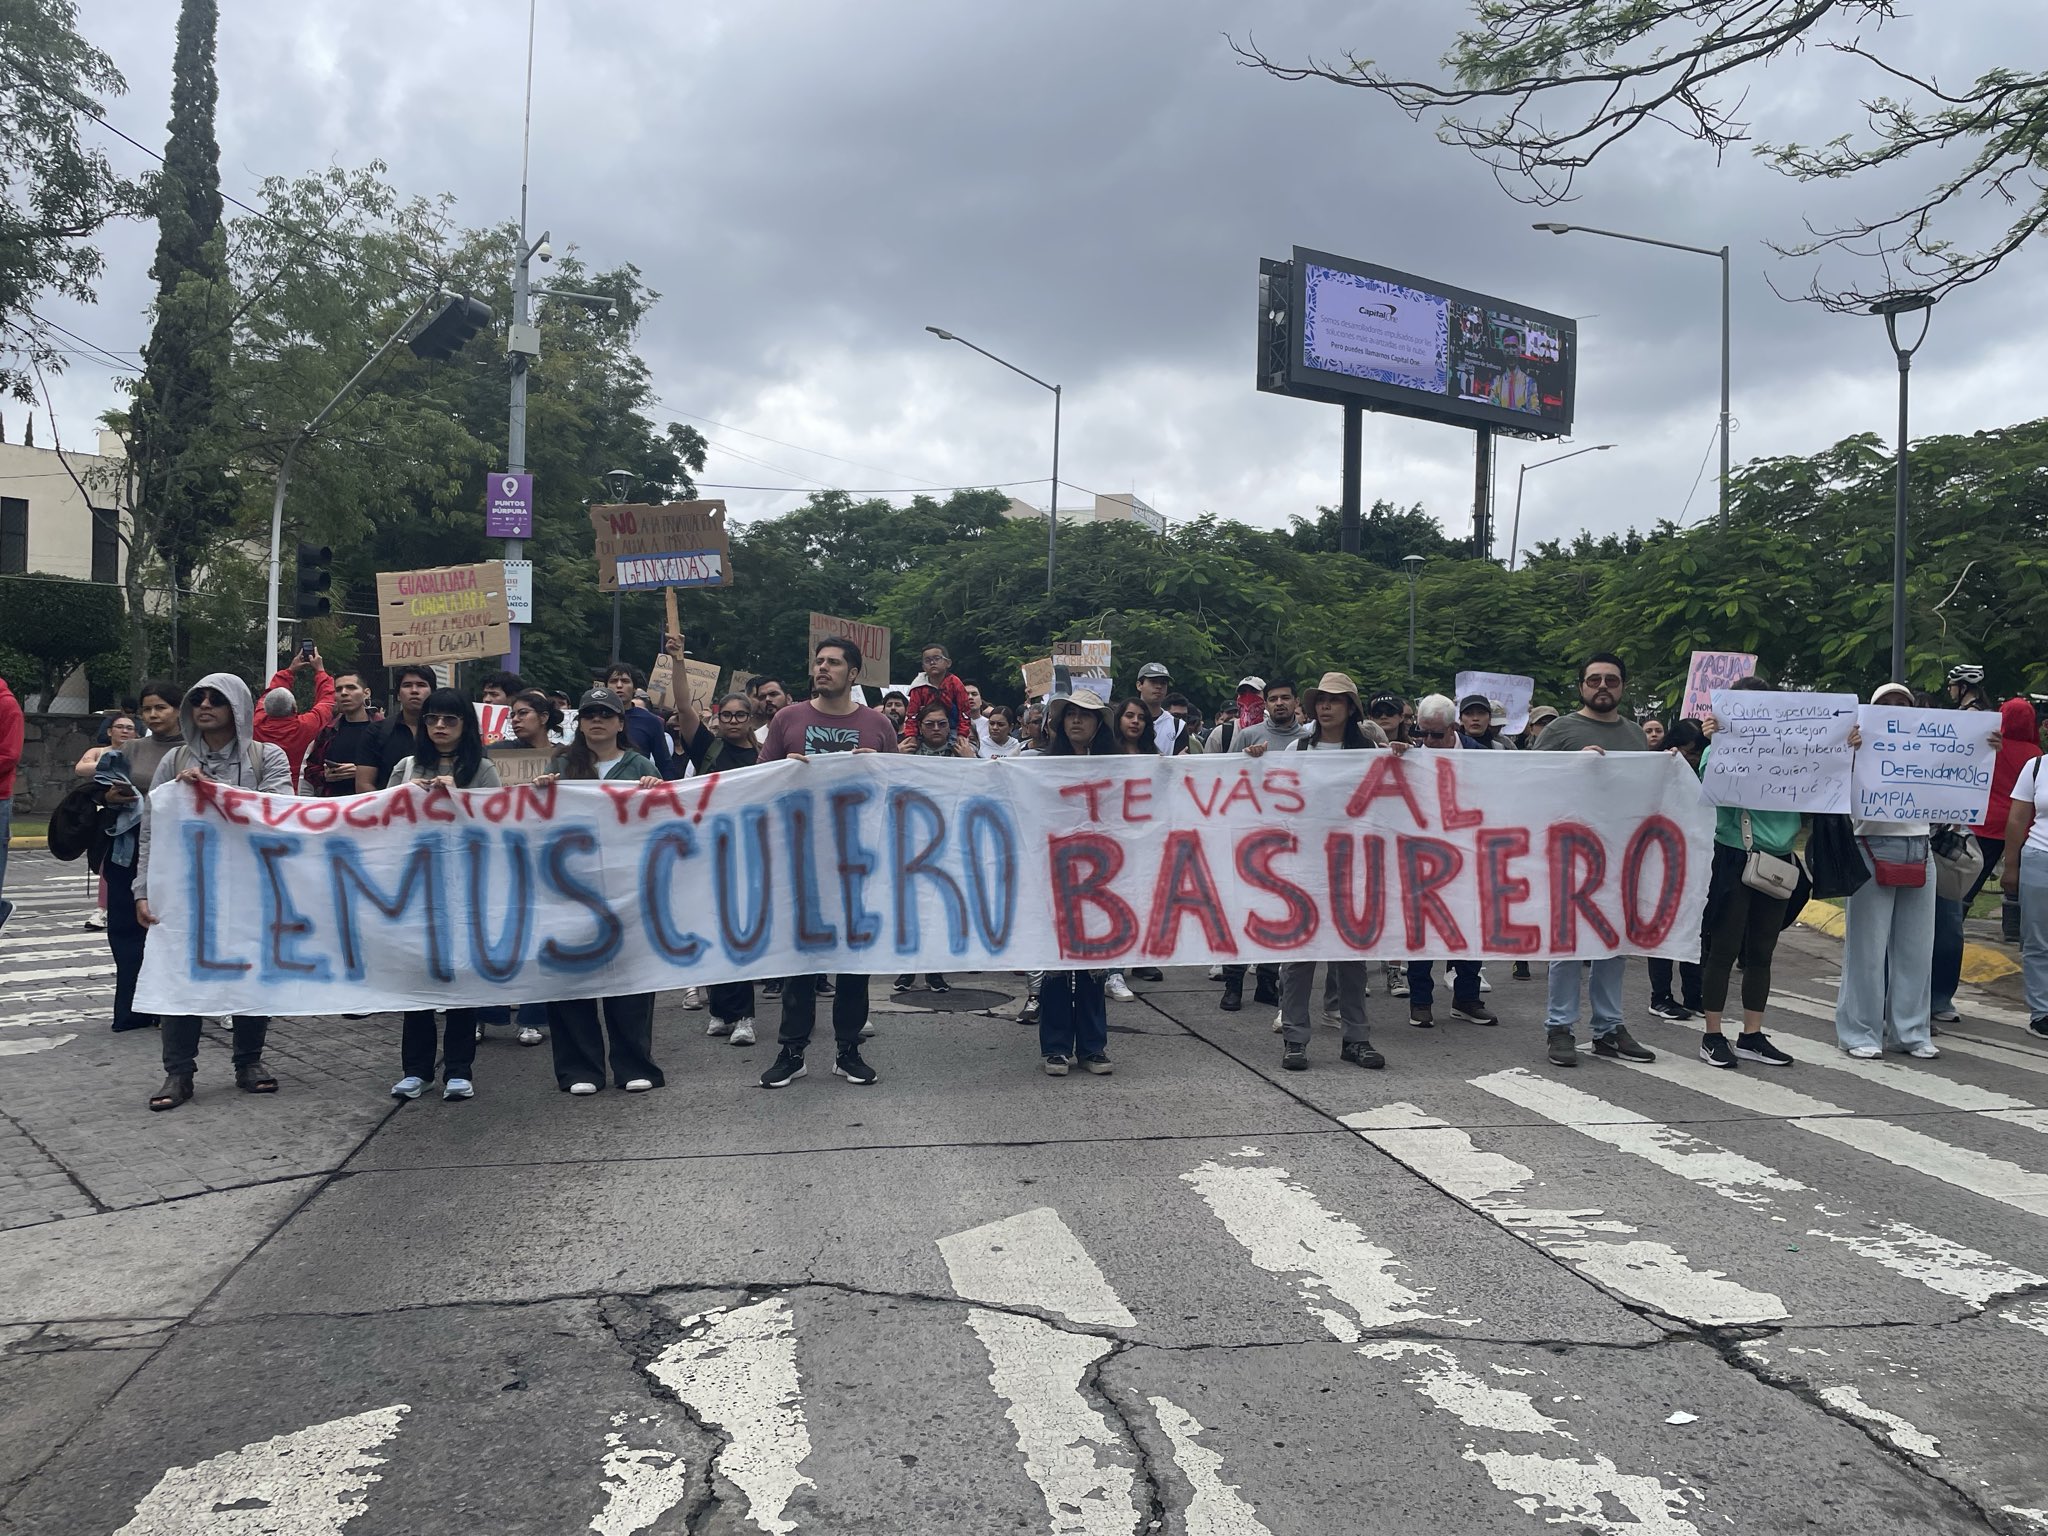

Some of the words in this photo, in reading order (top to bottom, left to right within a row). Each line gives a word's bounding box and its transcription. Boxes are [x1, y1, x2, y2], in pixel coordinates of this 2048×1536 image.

[1320, 314, 1339, 326] Somos
[1340, 319, 1383, 336] desarrolladores
[1383, 328, 1414, 343] impulsados
[1414, 337, 1424, 347] por
[1325, 327, 1355, 340] soluciones
[1369, 336, 1397, 350] avanzadas
[1330, 341, 1344, 350] Pero
[1344, 344, 1364, 355] puedes
[1364, 348, 1390, 360] llamarnos
[1390, 354, 1410, 365] Capital
[492, 506, 528, 515] PÚRPURA
[609, 510, 638, 535] NO
[623, 552, 710, 589] GENOCIDAS
[398, 569, 478, 596] GUADALAJARA
[410, 591, 488, 617] GUADALAJARA
[389, 641, 423, 660] PLOMO
[1056, 655, 1105, 667] GOBIERNA
[1775, 705, 1831, 721] supervisa
[1740, 725, 1767, 746] agua
[1887, 719, 1911, 734] EL
[1917, 722, 1957, 738] AGUA
[1717, 746, 1754, 756] correr
[1758, 747, 1776, 758] por
[1781, 741, 1799, 756] las
[1872, 741, 1897, 752] es
[1902, 740, 1922, 752] de
[601, 772, 721, 826] YA!
[1057, 775, 1153, 824] TE
[1345, 754, 1485, 831] AL
[1860, 789, 1916, 807] LIMPIA
[1864, 806, 1889, 819] LA
[182, 820, 623, 983] LEMUS
[639, 776, 1018, 967] CULERO
[1047, 813, 1688, 961] BASURERO
